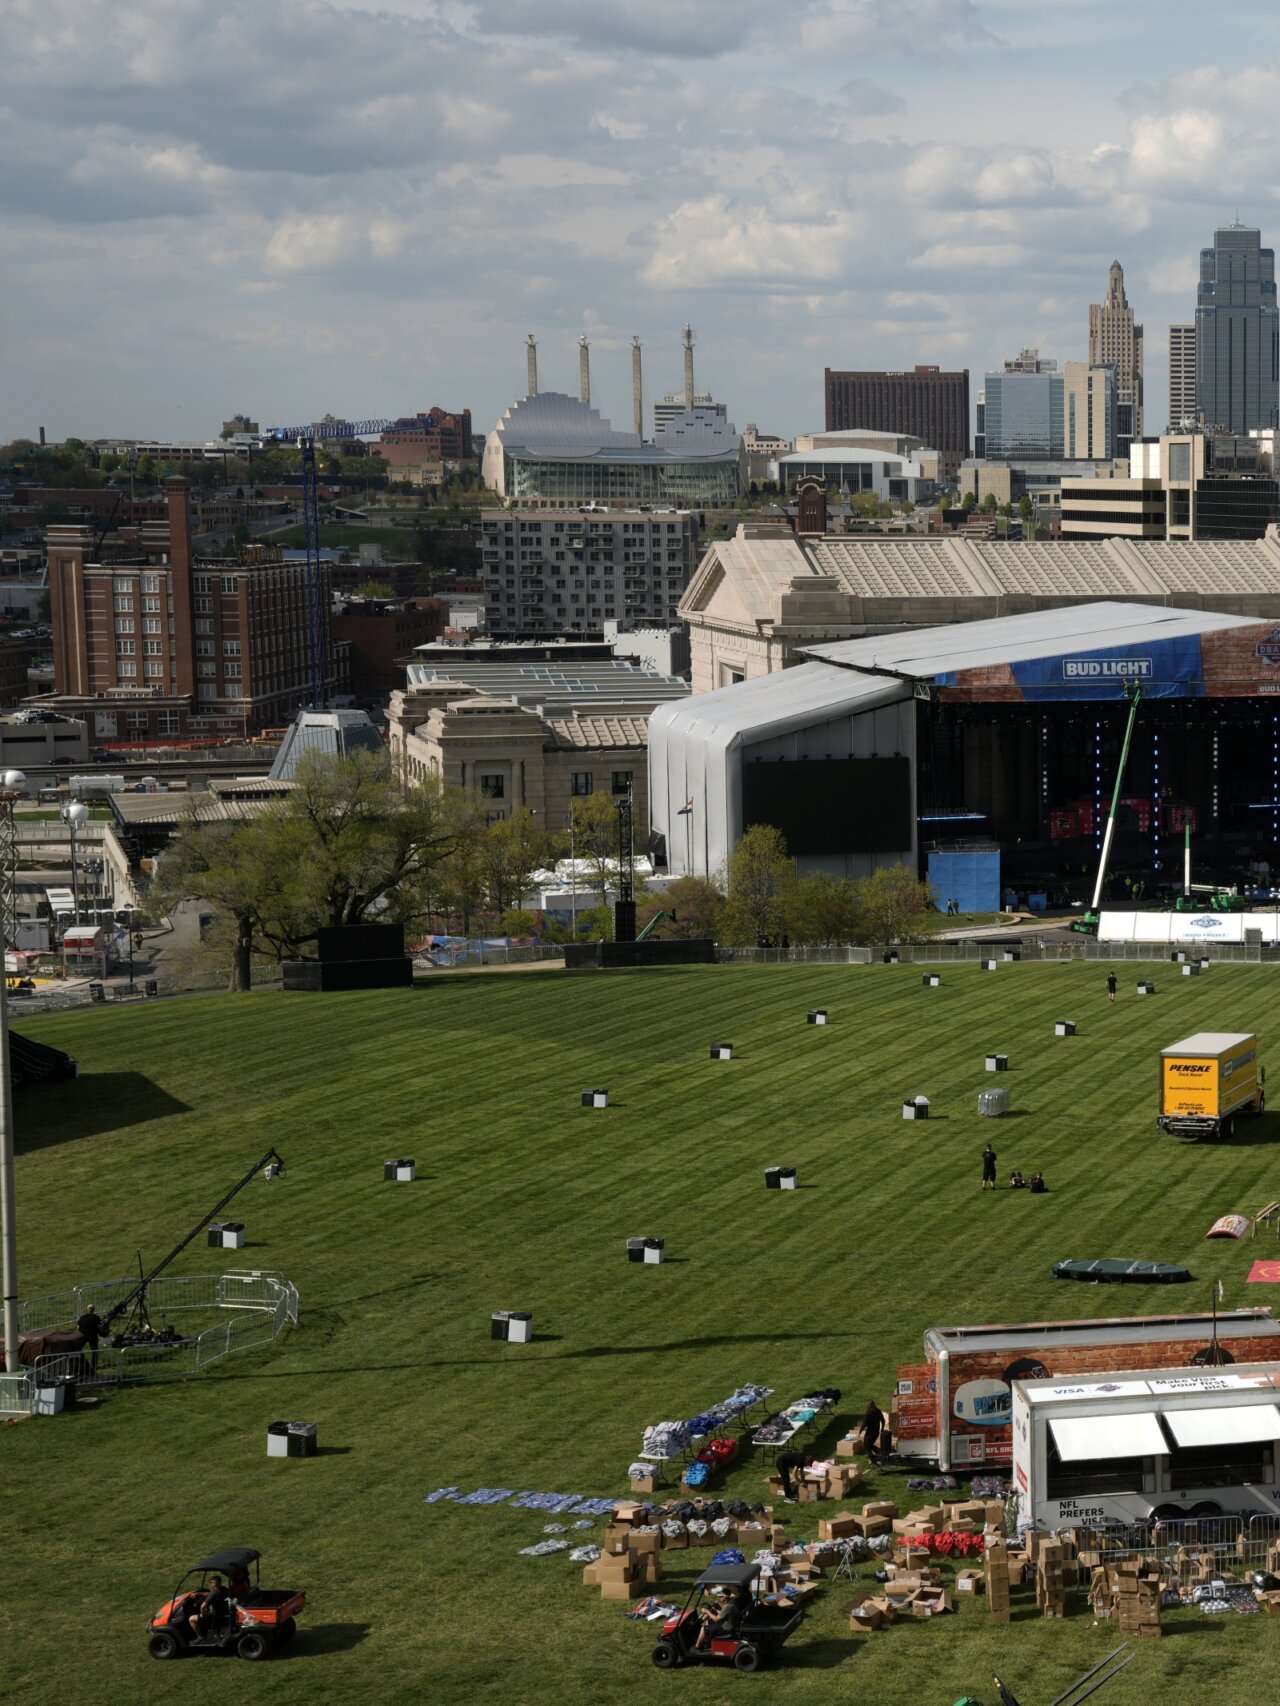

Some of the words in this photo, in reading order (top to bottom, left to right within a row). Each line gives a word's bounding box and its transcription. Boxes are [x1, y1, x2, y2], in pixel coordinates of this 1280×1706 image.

[1066, 663, 1101, 676] BUD
[1102, 661, 1149, 675] LIGHT
[1169, 1064, 1213, 1073] PENSKE
[1190, 1376, 1218, 1384] Visa
[1199, 1379, 1227, 1387] first
[1053, 1387, 1085, 1395] VISA
[1203, 1383, 1235, 1391] pick.
[1059, 1500, 1079, 1509] NFL
[1059, 1507, 1105, 1519] PREFERS
